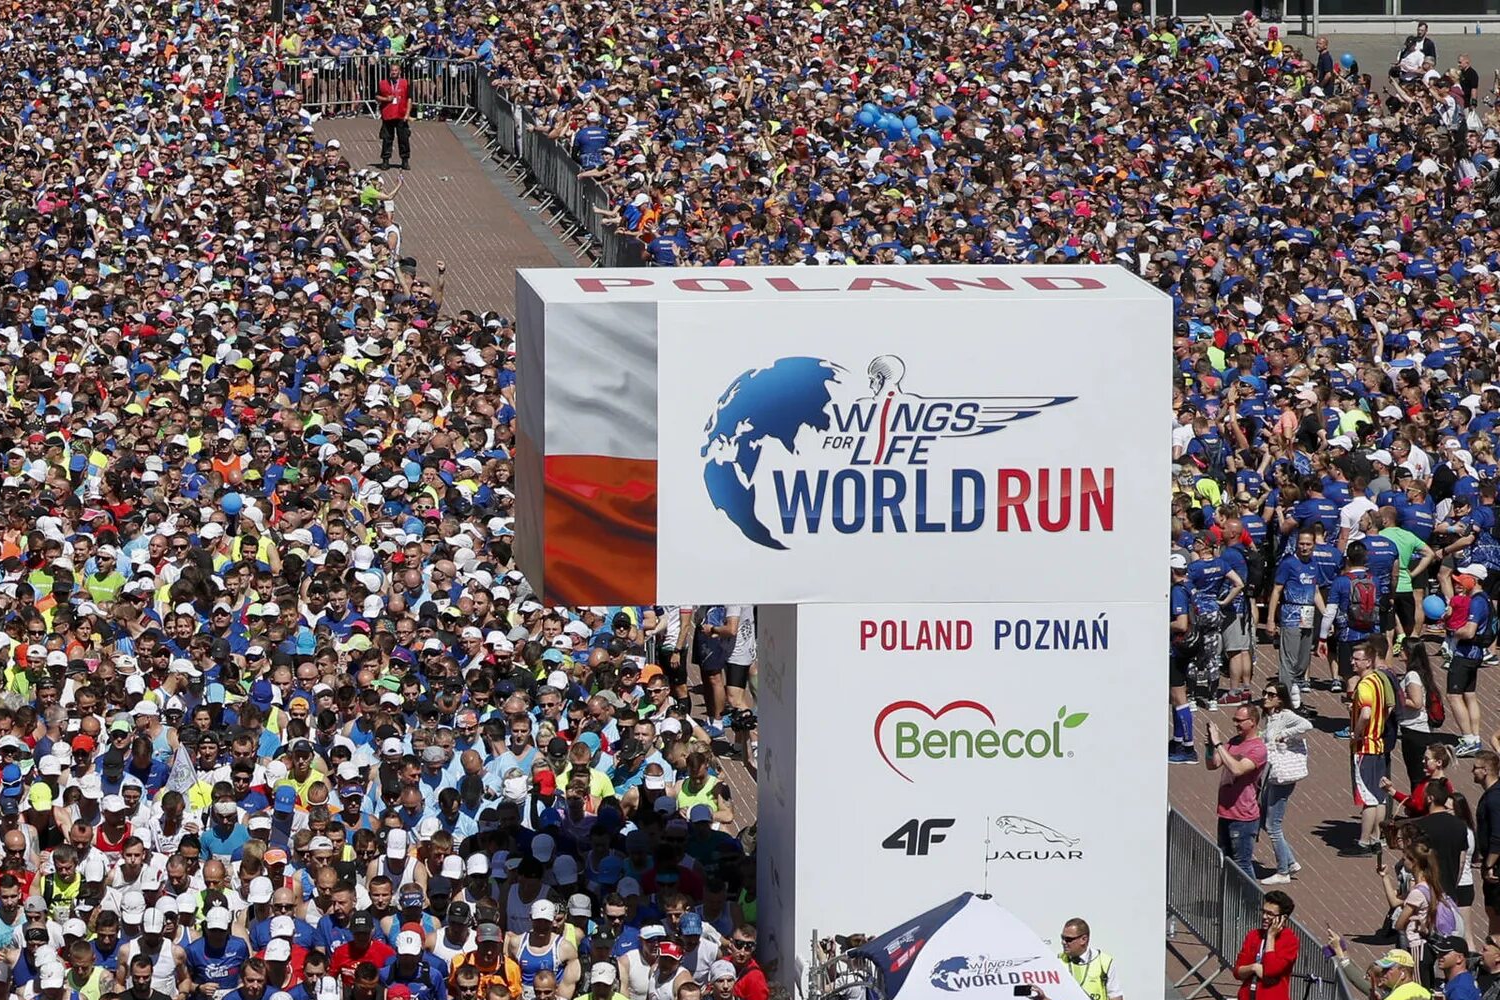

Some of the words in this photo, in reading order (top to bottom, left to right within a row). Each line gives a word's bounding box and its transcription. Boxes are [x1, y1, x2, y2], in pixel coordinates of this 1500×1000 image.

[573, 276, 1107, 292] POLAND
[831, 391, 980, 433] WINGS
[821, 436, 852, 450] FOR
[851, 434, 936, 466] LIFE
[772, 467, 985, 533] WORLD
[998, 467, 1114, 532] RUN
[859, 619, 973, 651] POLAND
[994, 612, 1110, 650] POZNAŃ
[895, 720, 1064, 760] Benecol
[881, 818, 956, 856] 4F
[985, 850, 1083, 861] JAGUAR
[953, 971, 1021, 989] WORLD
[1021, 970, 1060, 985] RUN
[968, 959, 1013, 971] WINGS
